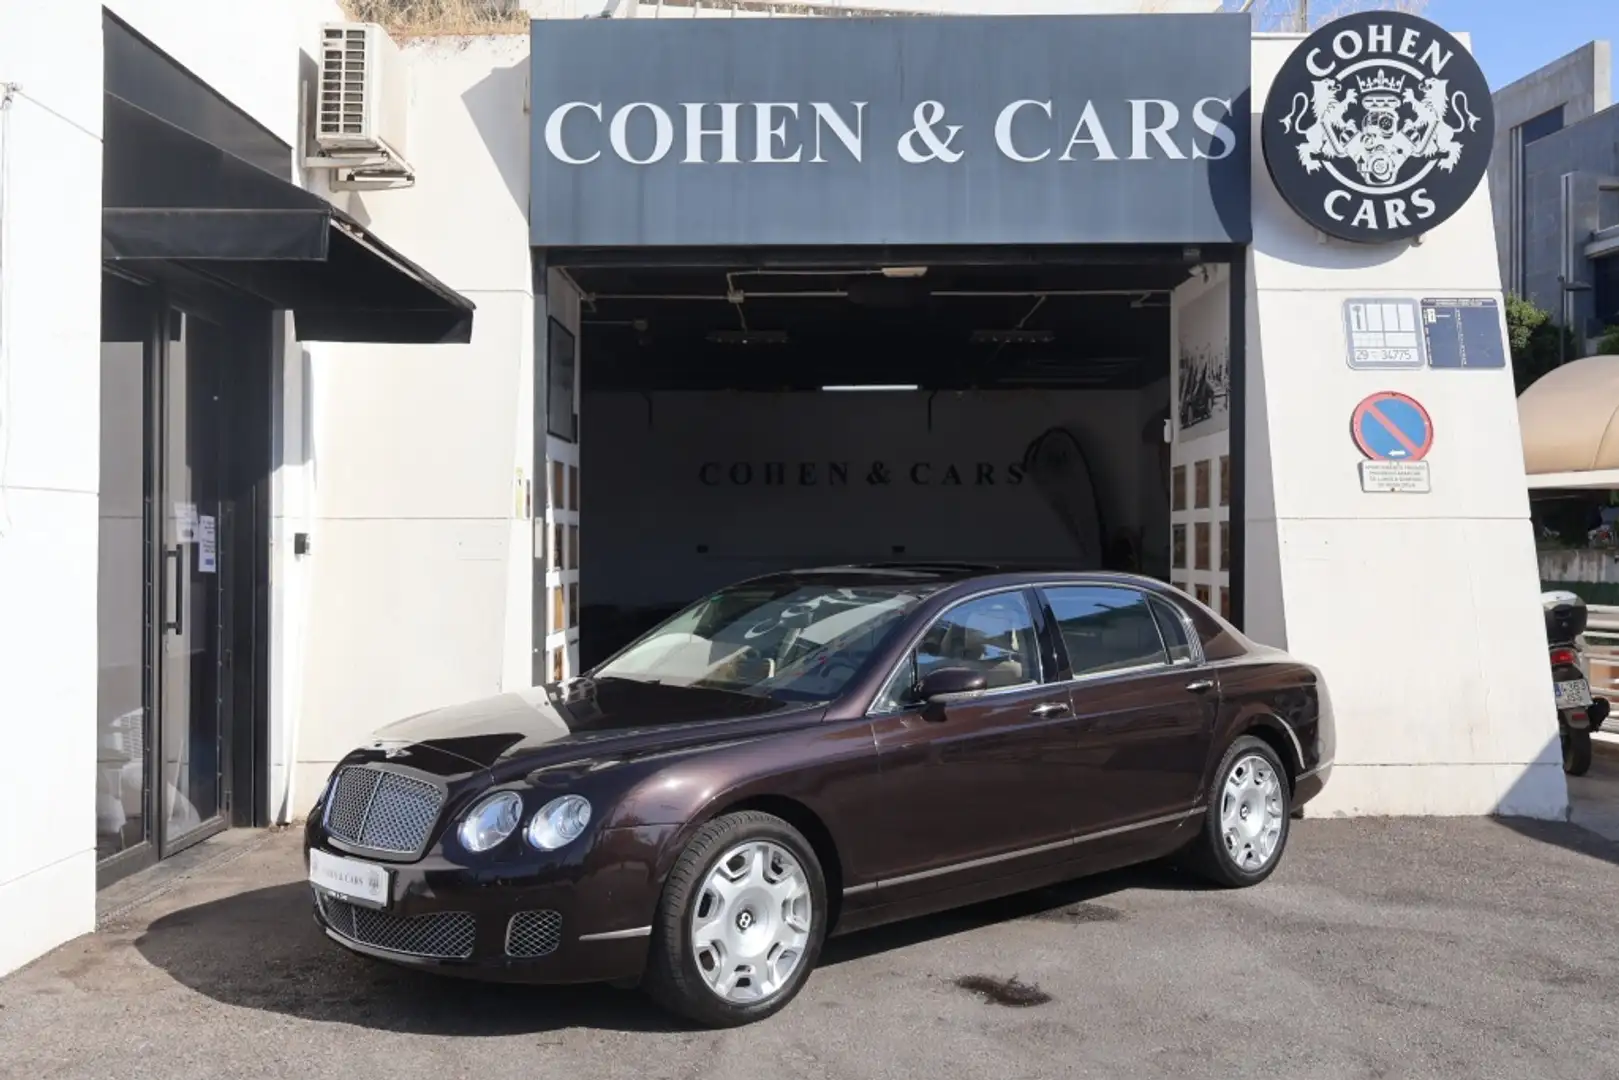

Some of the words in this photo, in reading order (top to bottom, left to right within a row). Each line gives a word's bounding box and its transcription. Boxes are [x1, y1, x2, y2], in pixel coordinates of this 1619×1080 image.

[1306, 24, 1454, 78] COHEN
[544, 100, 869, 165] COHEN
[897, 99, 965, 164] &
[994, 96, 1237, 162] CARS
[1323, 187, 1436, 230] CARS
[698, 461, 849, 487] COHEN
[866, 460, 892, 486] &
[910, 461, 1025, 486] CARS
